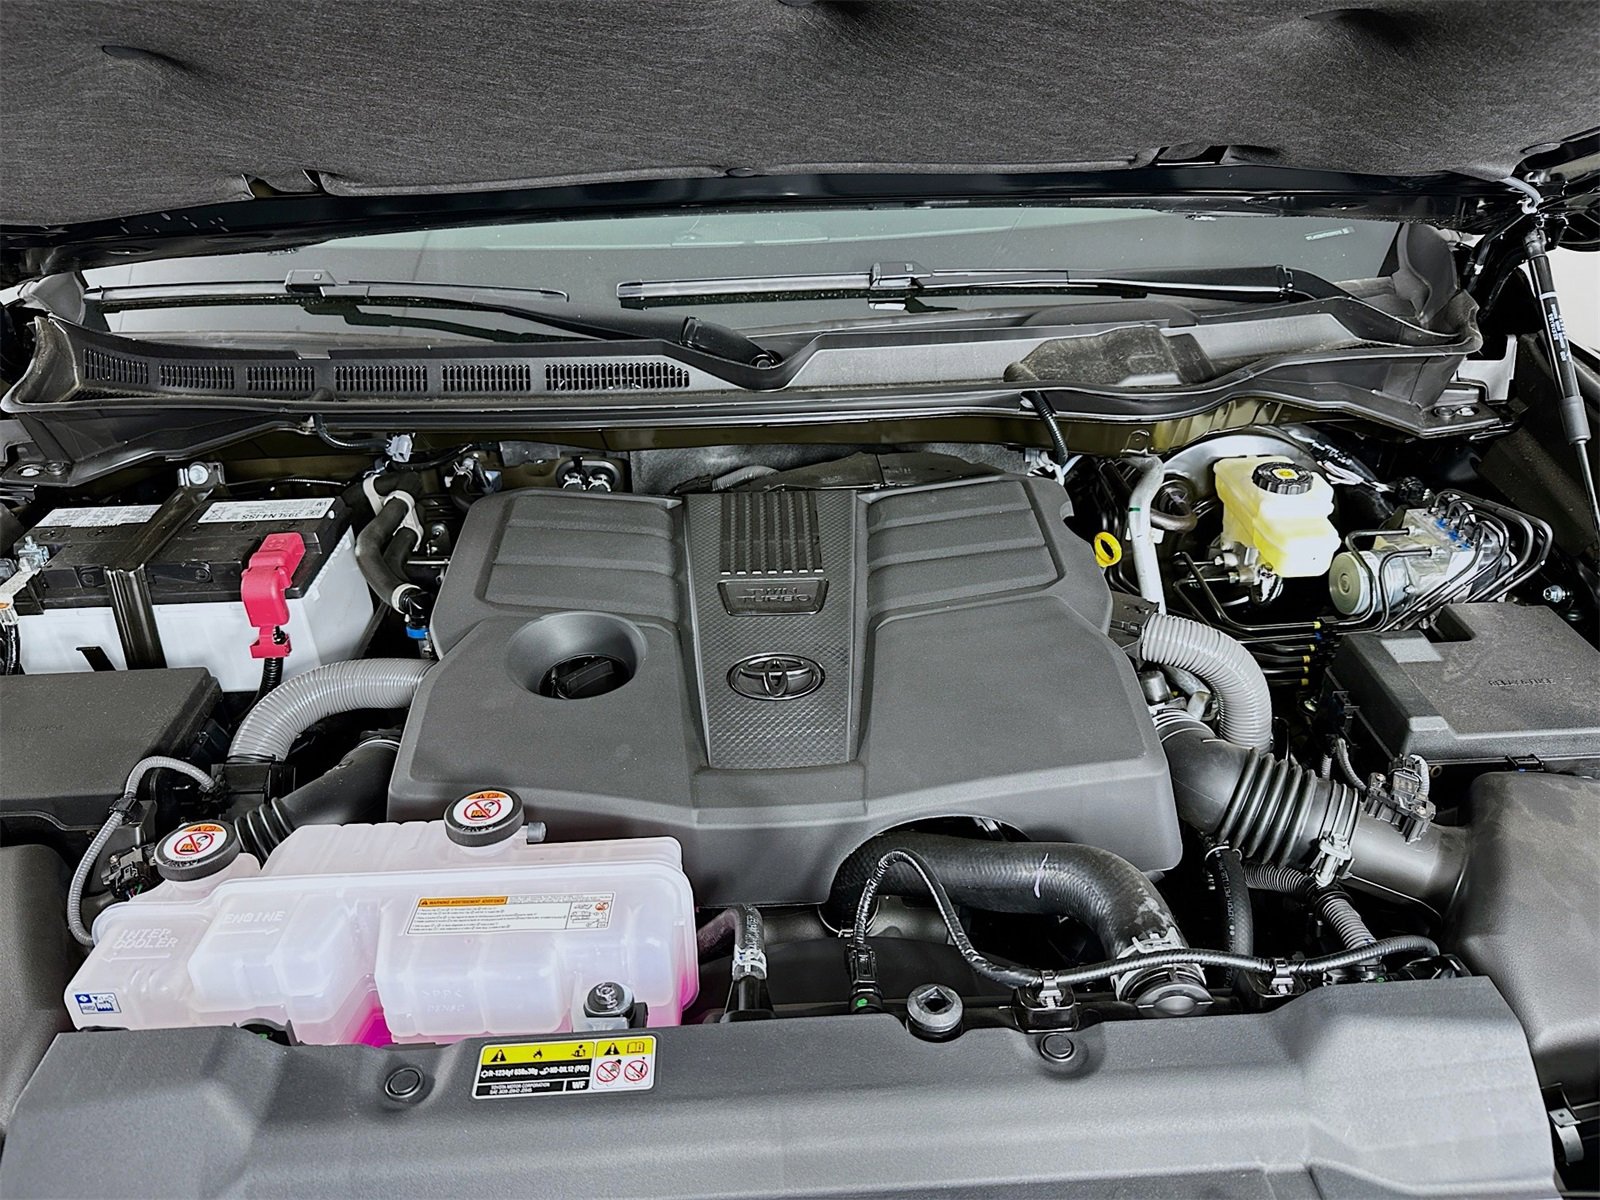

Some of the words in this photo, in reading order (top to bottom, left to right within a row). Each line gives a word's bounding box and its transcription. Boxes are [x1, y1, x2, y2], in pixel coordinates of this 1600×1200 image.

[746, 587, 798, 595] TWIN
[736, 594, 812, 603] TURBO
[223, 911, 286, 924] ENGINE
[119, 928, 173, 940] INTER
[113, 937, 178, 949] COOLER
[572, 1081, 586, 1089] WF
